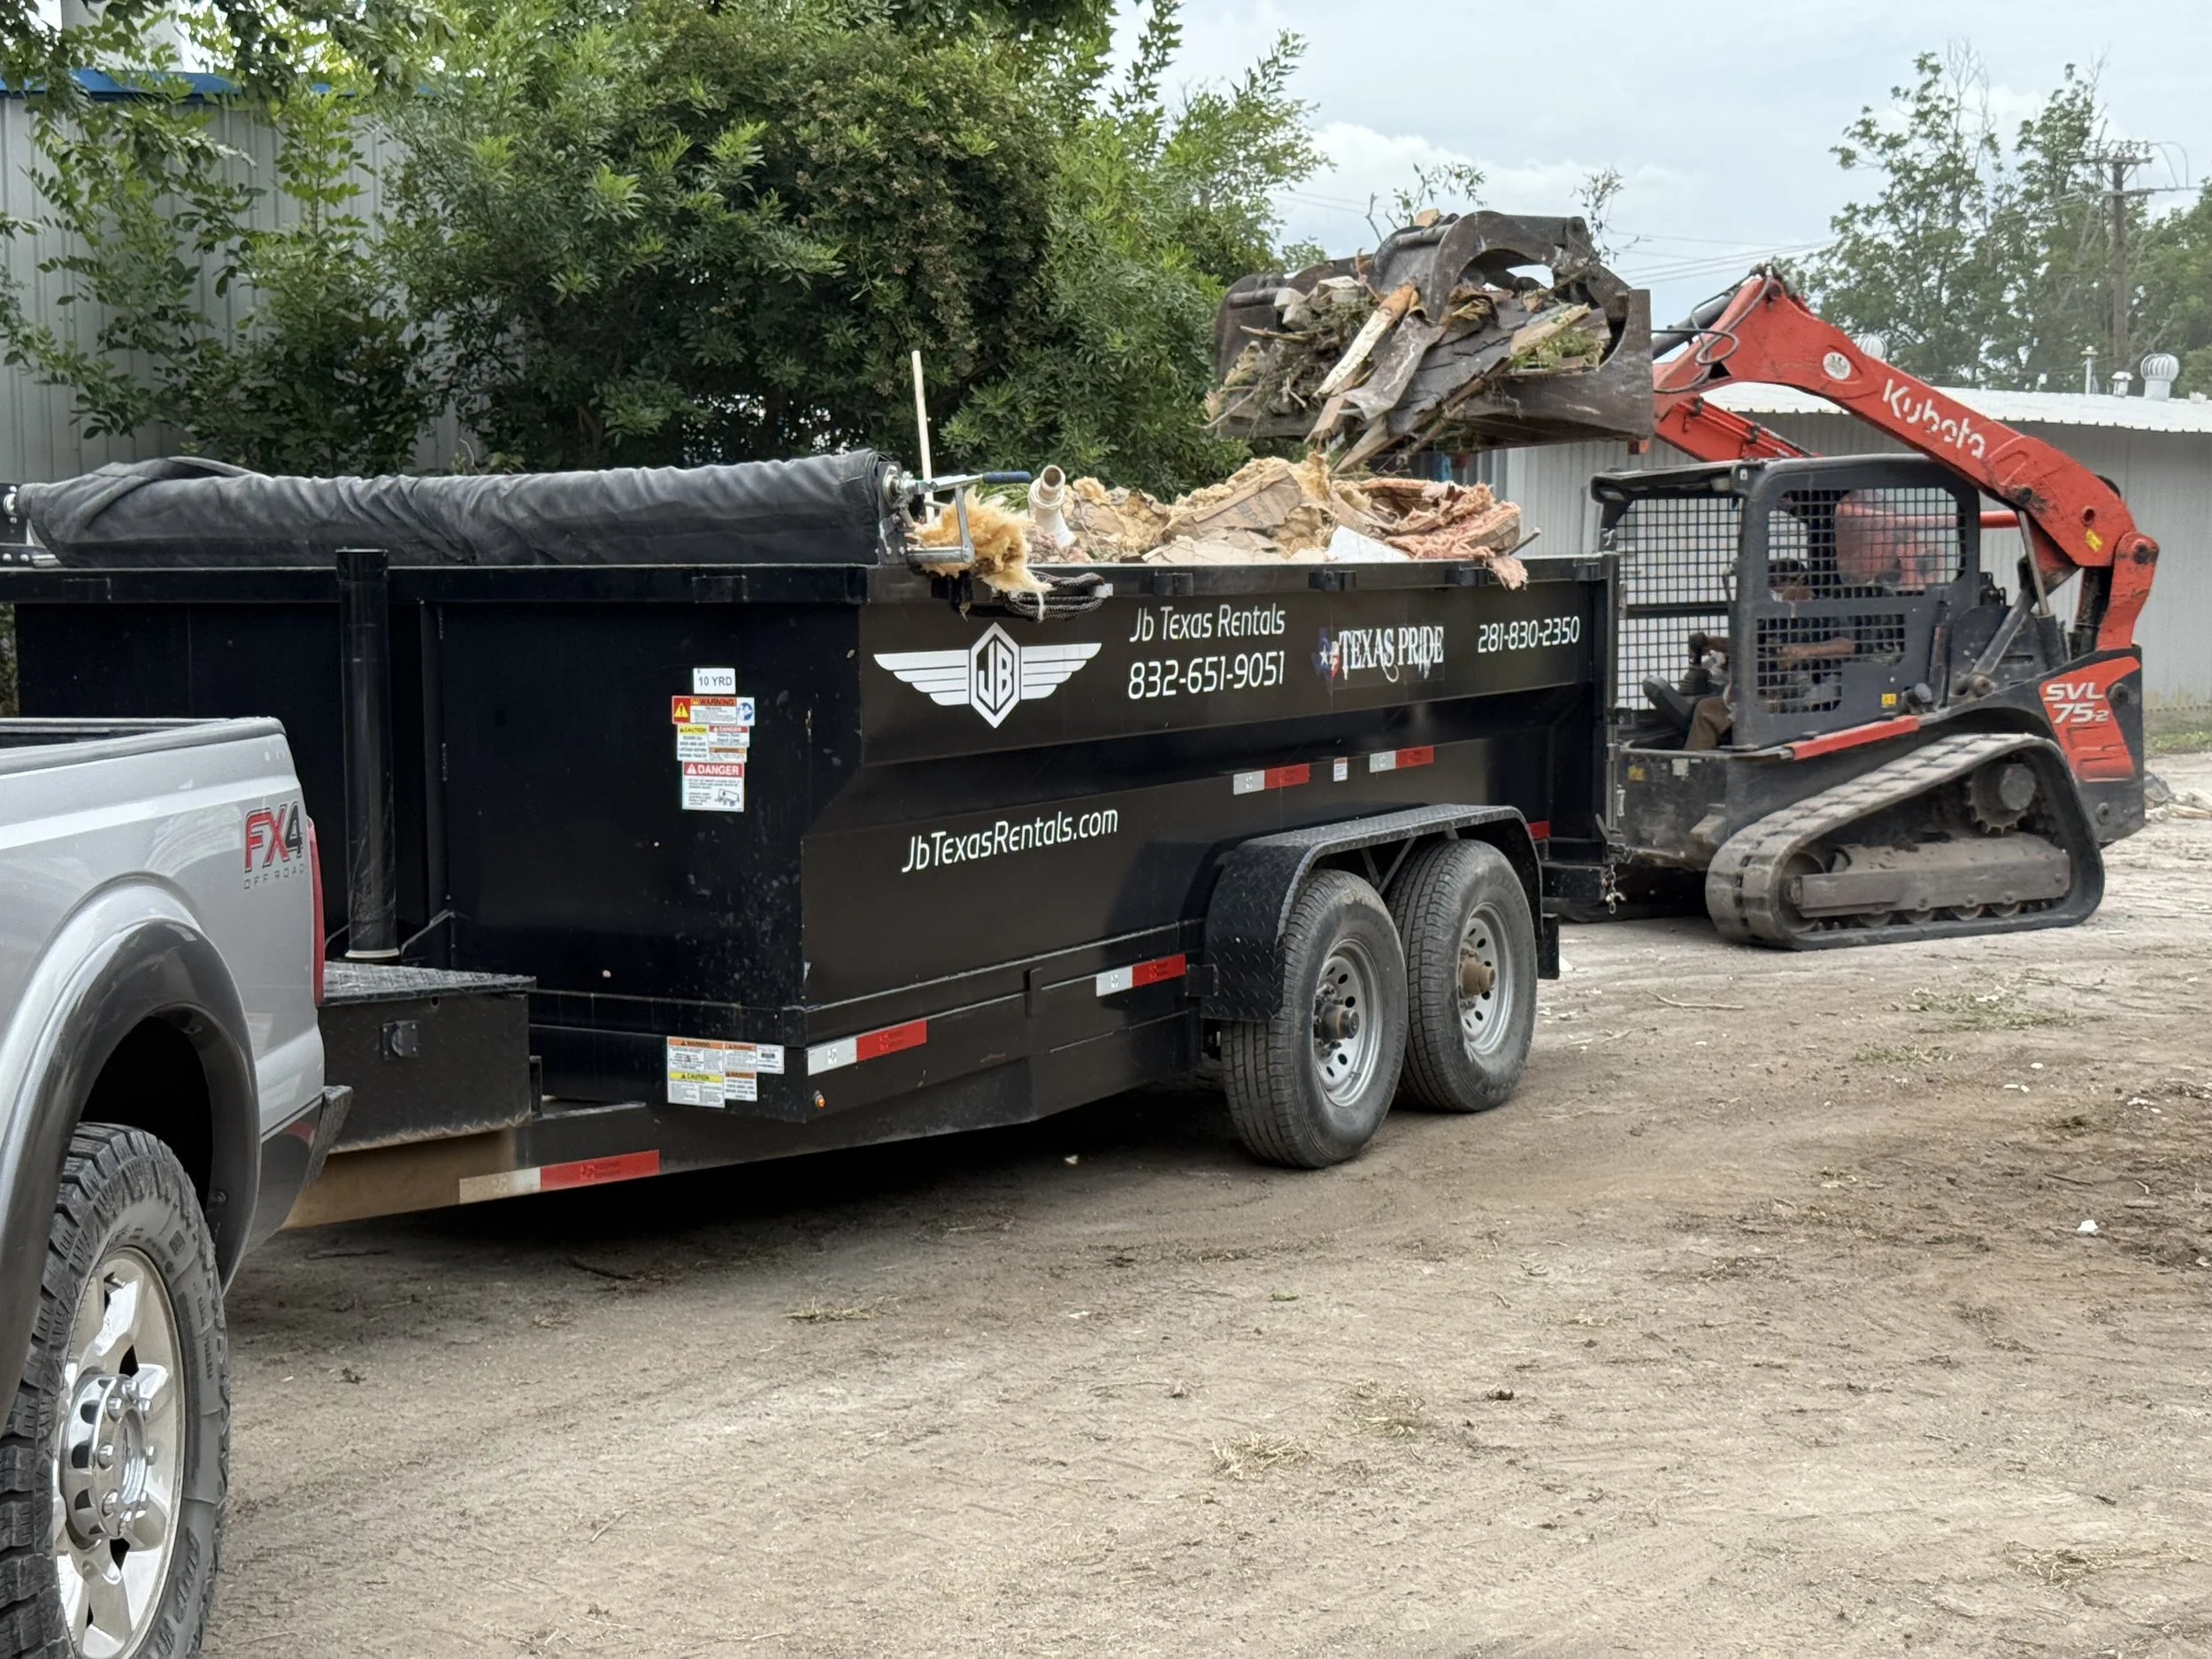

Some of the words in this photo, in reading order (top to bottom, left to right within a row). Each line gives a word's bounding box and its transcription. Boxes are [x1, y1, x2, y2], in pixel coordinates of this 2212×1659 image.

[1882, 379, 1985, 458] Kubota
[1130, 608, 1154, 643] Jb
[1160, 606, 1212, 641] Texas
[1217, 603, 1286, 637] Rentals
[1478, 616, 1580, 653] 281-830-2350
[978, 638, 1014, 704] JB
[1339, 627, 1399, 682] TEXAS
[1398, 626, 1444, 680] PRIDE
[699, 676, 709, 687] 10
[711, 676, 733, 687] YRD
[1128, 650, 1286, 700] 832-651-9051
[2042, 681, 2104, 701] SVL
[2053, 702, 2109, 724] 75-2
[697, 764, 740, 775] DANGER
[244, 801, 303, 872] FX4
[902, 810, 1118, 872] JbTexasRentals.com
[244, 872, 269, 890] OFF
[274, 864, 304, 879] ROAD
